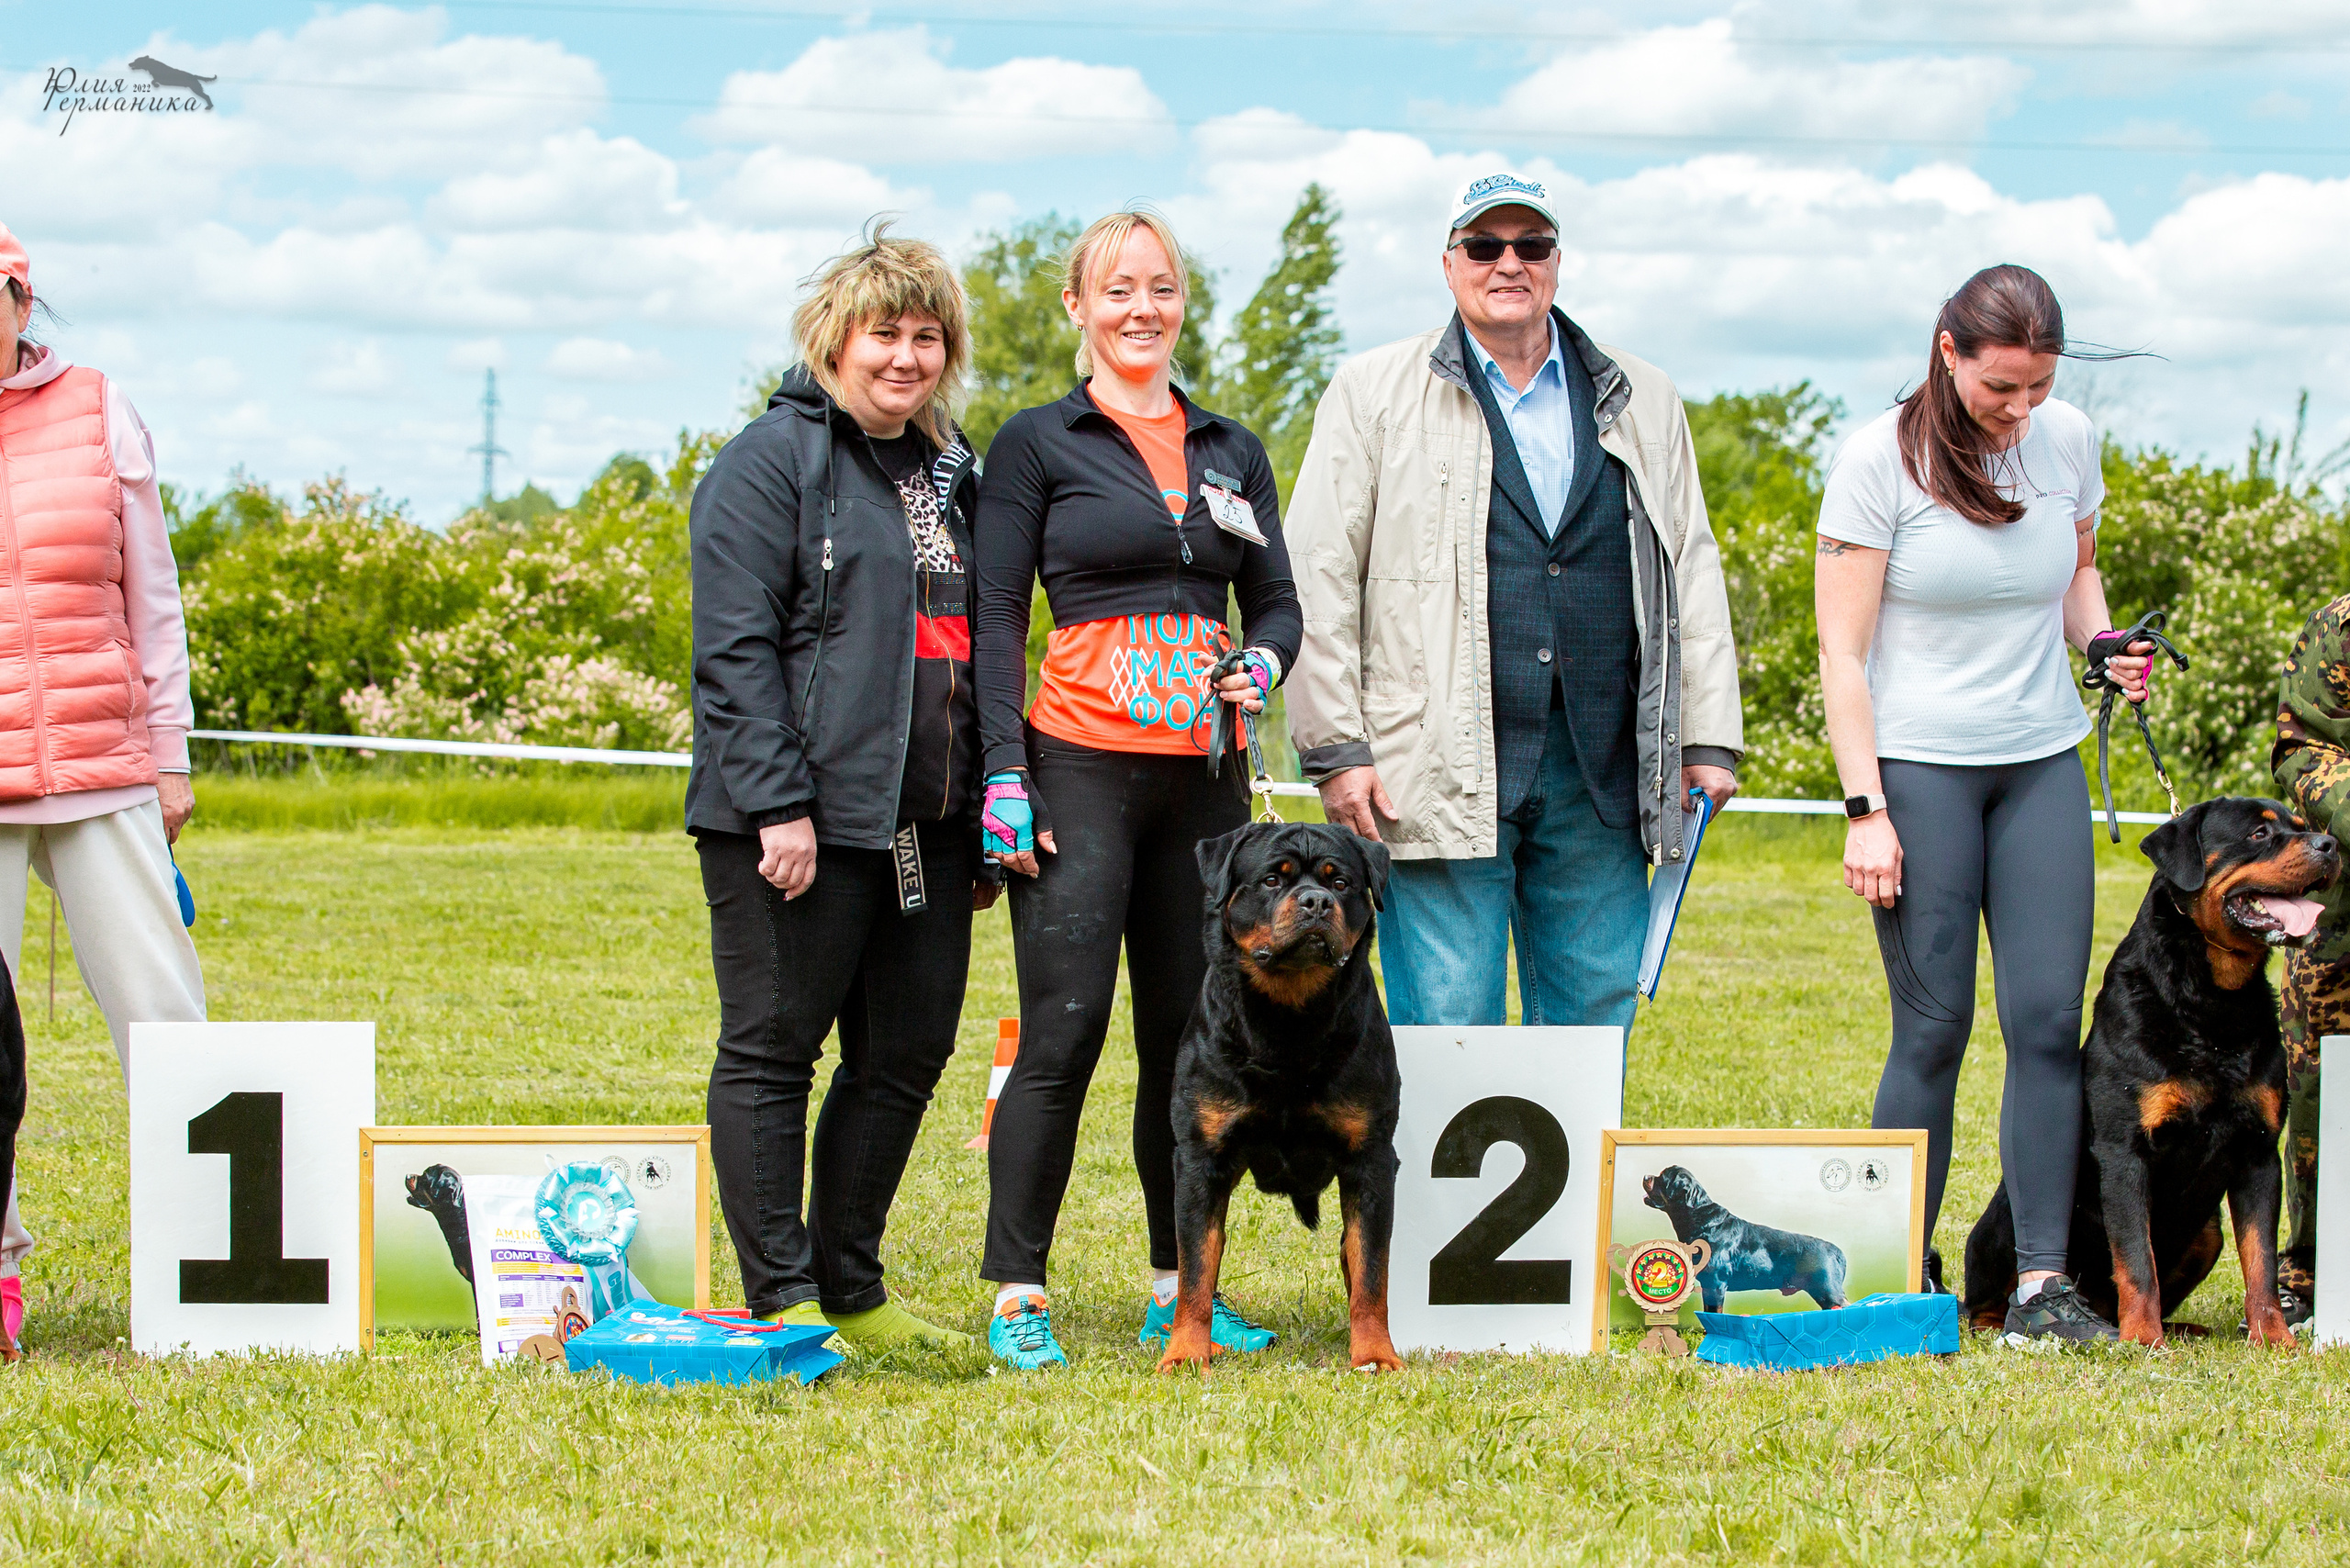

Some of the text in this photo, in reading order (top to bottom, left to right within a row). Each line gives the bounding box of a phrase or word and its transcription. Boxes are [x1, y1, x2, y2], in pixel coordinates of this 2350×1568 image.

[1130, 650, 1214, 688] МАР
[1129, 692, 1215, 731] ФОН
[896, 826, 919, 890] WAKE
[179, 1092, 330, 1305] 1
[1428, 1095, 1572, 1305] 2
[496, 1227, 541, 1240] AMINO
[496, 1250, 552, 1261] COMPLEX
[1652, 1260, 1668, 1288] 2
[1648, 1287, 1673, 1295] МЕСТО
